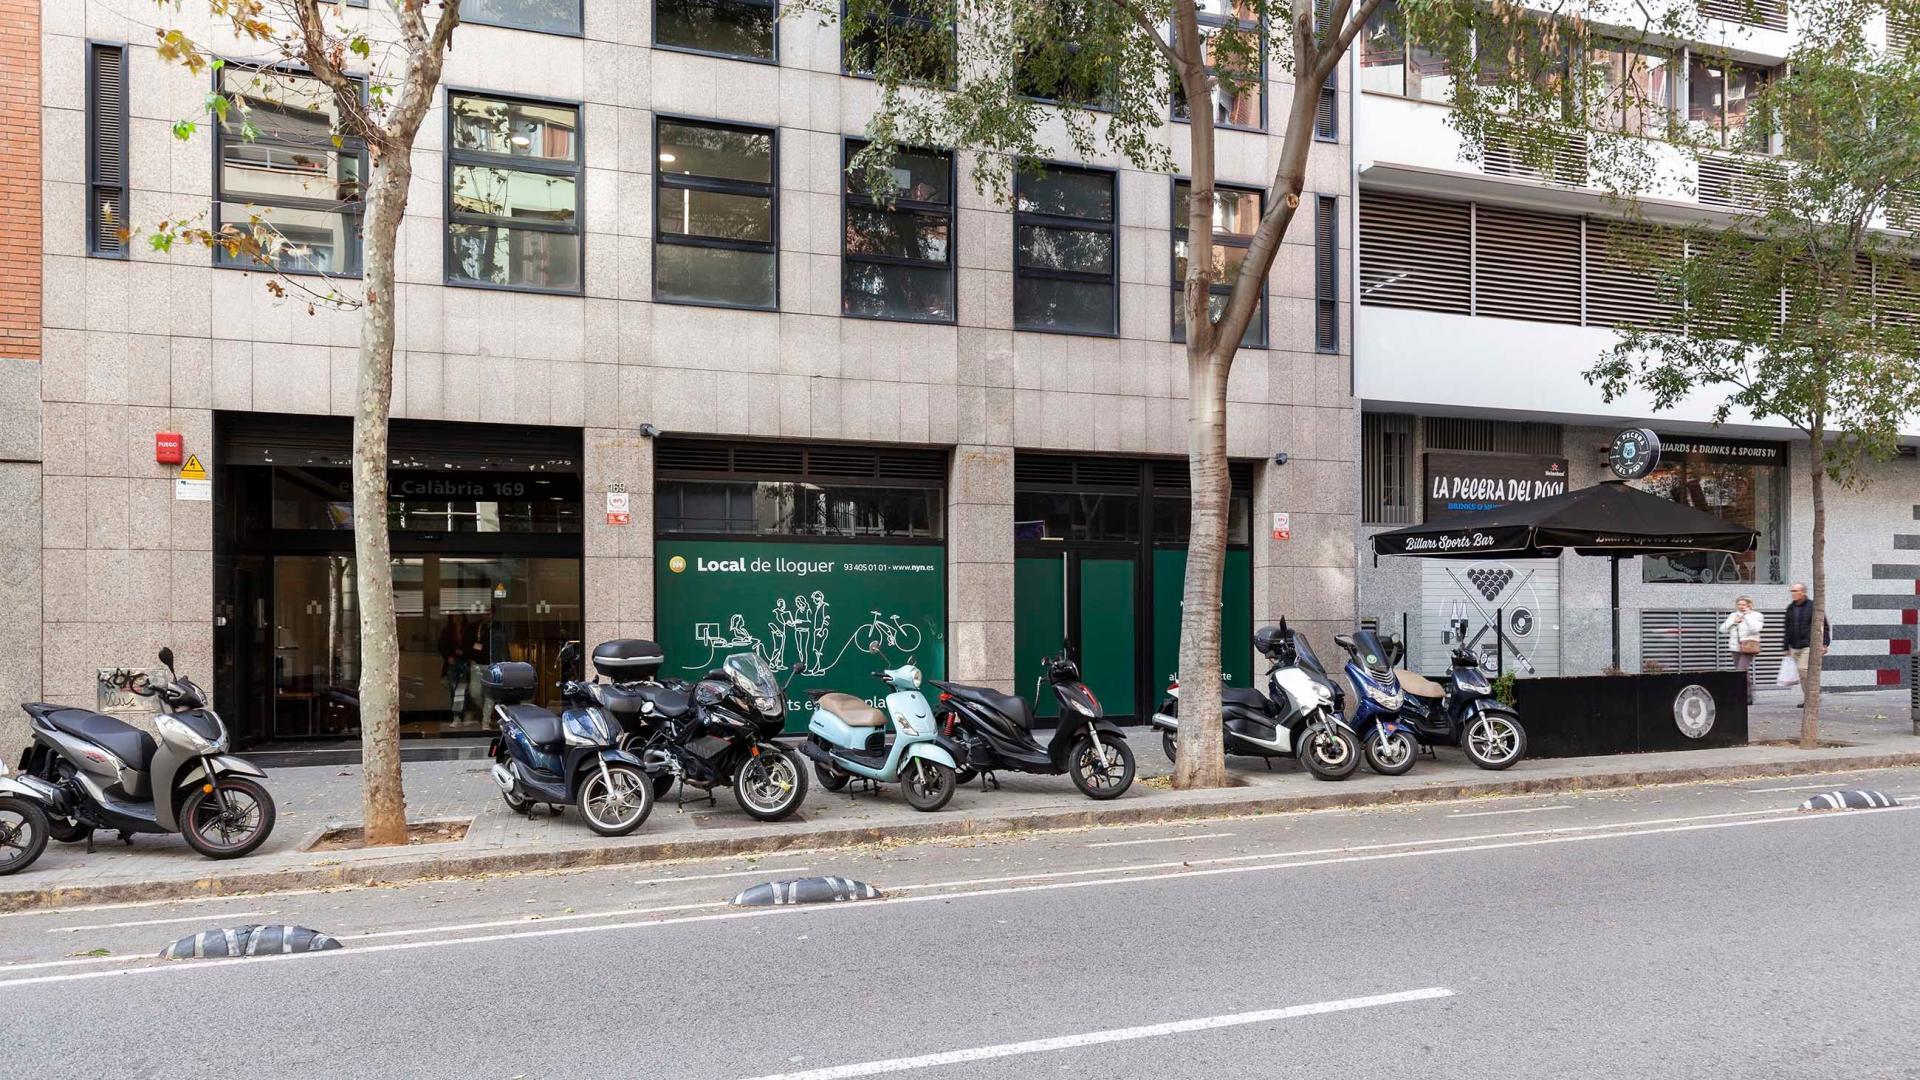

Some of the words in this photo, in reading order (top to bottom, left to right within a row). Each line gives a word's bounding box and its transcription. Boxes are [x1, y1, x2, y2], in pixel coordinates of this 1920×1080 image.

[1613, 440, 1621, 450] LA
[1622, 432, 1645, 446] PECERA
[1699, 444, 1730, 455] DRINKS
[1738, 447, 1766, 457] SPORTS
[1767, 449, 1777, 457] TV
[1615, 464, 1626, 474] DEL
[401, 479, 484, 496] Calàbria
[493, 482, 525, 496] 169
[608, 483, 626, 493] 169
[1432, 476, 1449, 499] LA
[1452, 477, 1505, 501] PECERA
[1508, 479, 1531, 502] DEL
[1405, 537, 1437, 551] Billars
[1438, 535, 1471, 551] Sports
[1472, 532, 1495, 546] Bar
[697, 557, 746, 572] Local
[750, 557, 771, 572] de
[776, 557, 835, 576] lloguer
[843, 563, 853, 571] 93
[853, 563, 867, 571] 405
[868, 563, 877, 571] 01
[878, 563, 887, 571] 01
[892, 564, 935, 573] www.nyn.es
